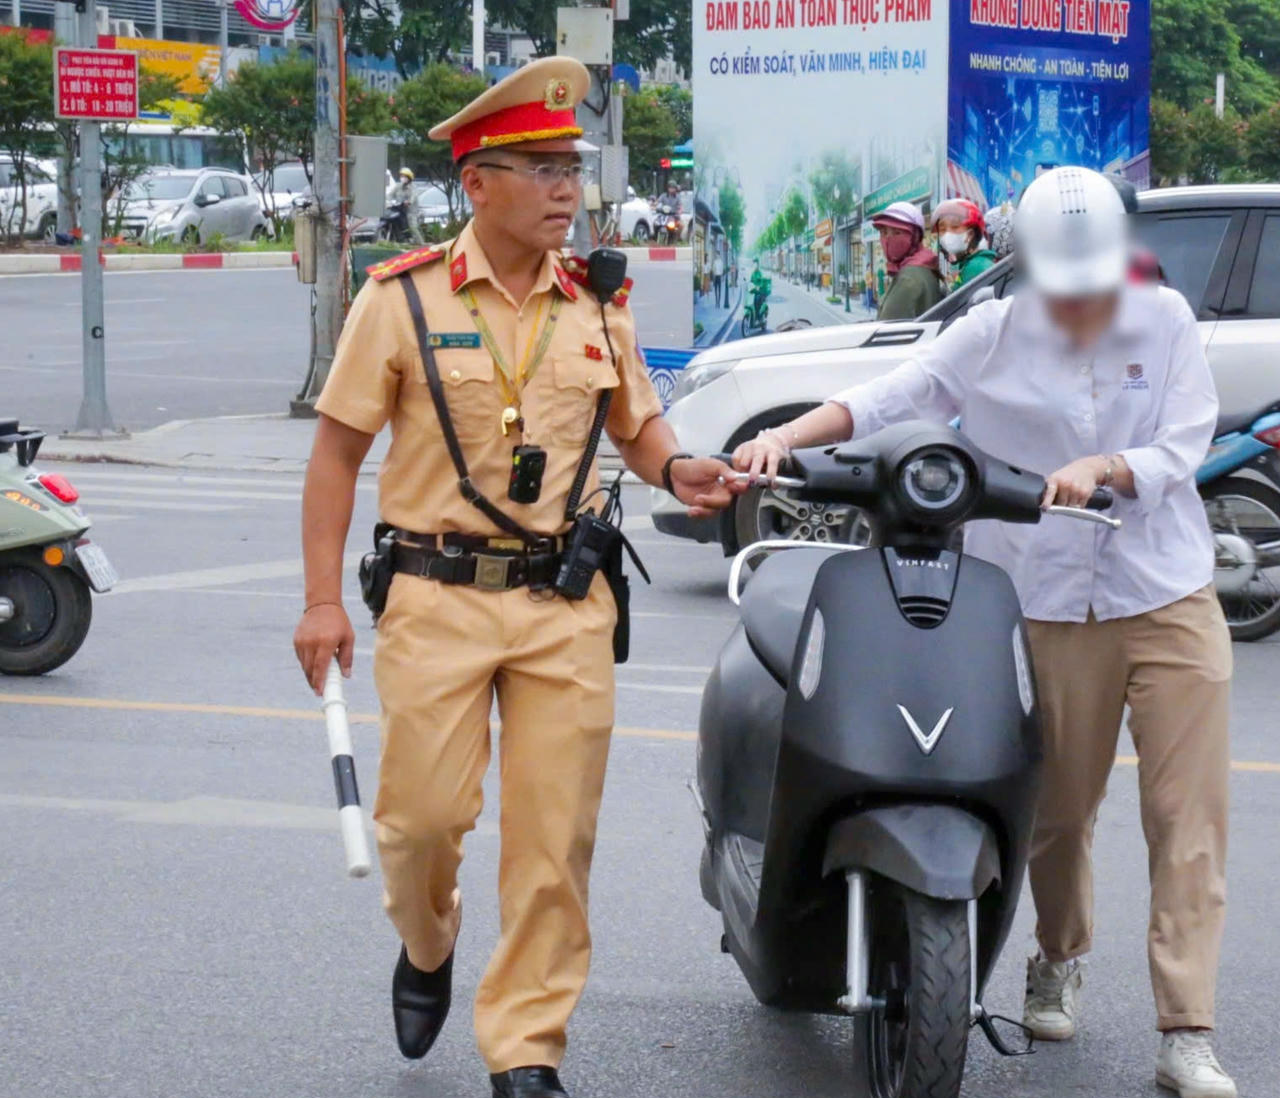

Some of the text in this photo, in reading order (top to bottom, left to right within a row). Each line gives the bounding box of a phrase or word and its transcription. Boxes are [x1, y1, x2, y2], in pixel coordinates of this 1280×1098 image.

[710, 46, 928, 76] CÓ KIỂM SOÁT, VĂN MINH, HIỆN ĐẠI
[970, 53, 1001, 71] NHANH
[1004, 54, 1036, 73] CHÓNG
[1044, 60, 1059, 74] AN
[1060, 57, 1084, 76] TOÀN
[1092, 59, 1112, 81] TIỆN
[1114, 62, 1129, 82] LỢI
[896, 560, 949, 571] VINFAST
